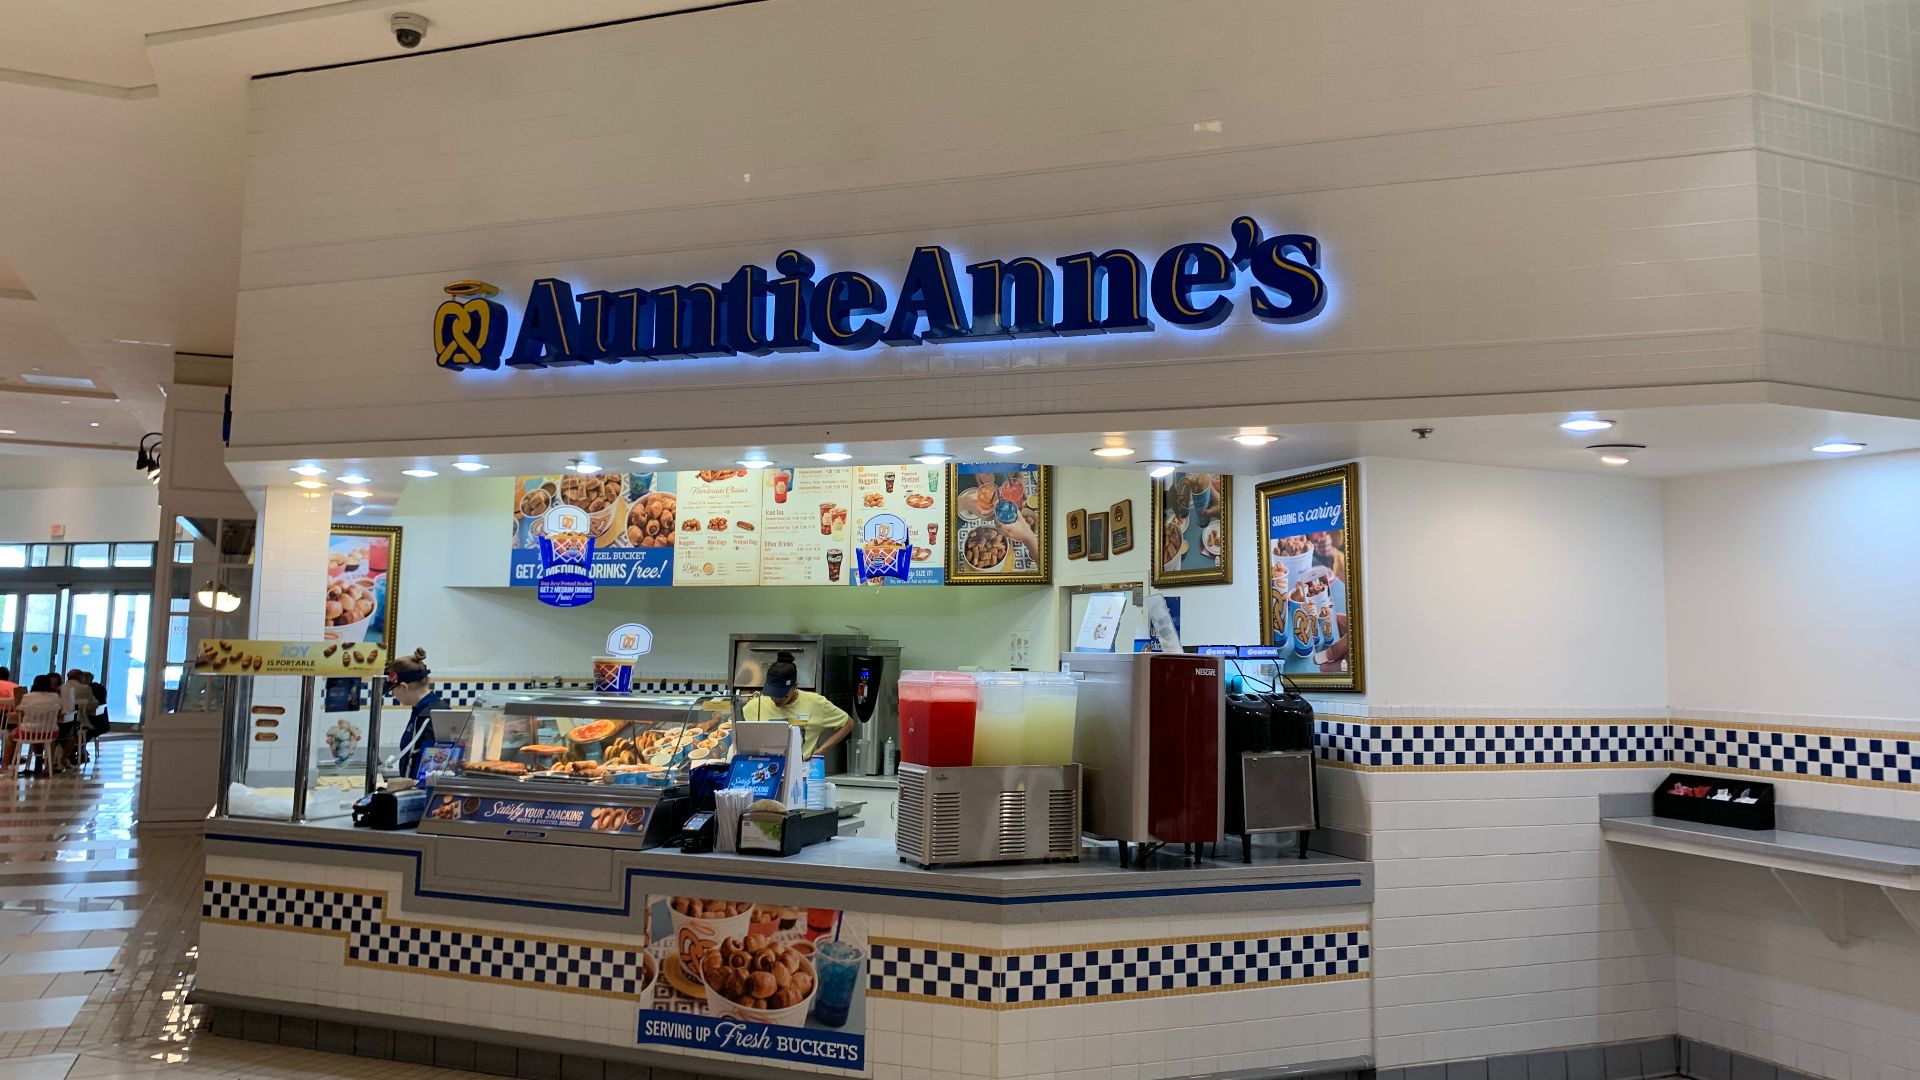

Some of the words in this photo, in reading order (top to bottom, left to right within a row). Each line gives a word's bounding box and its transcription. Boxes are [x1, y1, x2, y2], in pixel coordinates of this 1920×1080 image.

[1272, 512, 1297, 527] SHARING
[1298, 511, 1305, 523] IS
[1305, 501, 1341, 526] caring
[591, 551, 612, 561] TZEL
[613, 551, 647, 561] BUCKET
[515, 563, 536, 579] GET
[536, 563, 544, 579] 2
[588, 563, 627, 579] DRINKS
[625, 559, 667, 585] free!
[279, 646, 310, 659] JOY
[275, 659, 316, 667] PORTABLE
[484, 801, 524, 821] Satisfy
[524, 807, 545, 819] YOUR
[545, 808, 585, 821] SNACKING
[645, 1020, 693, 1040] SERVING
[695, 1026, 711, 1042] UP
[714, 1021, 773, 1050] Fresh
[776, 1035, 859, 1061] BUCKETS
